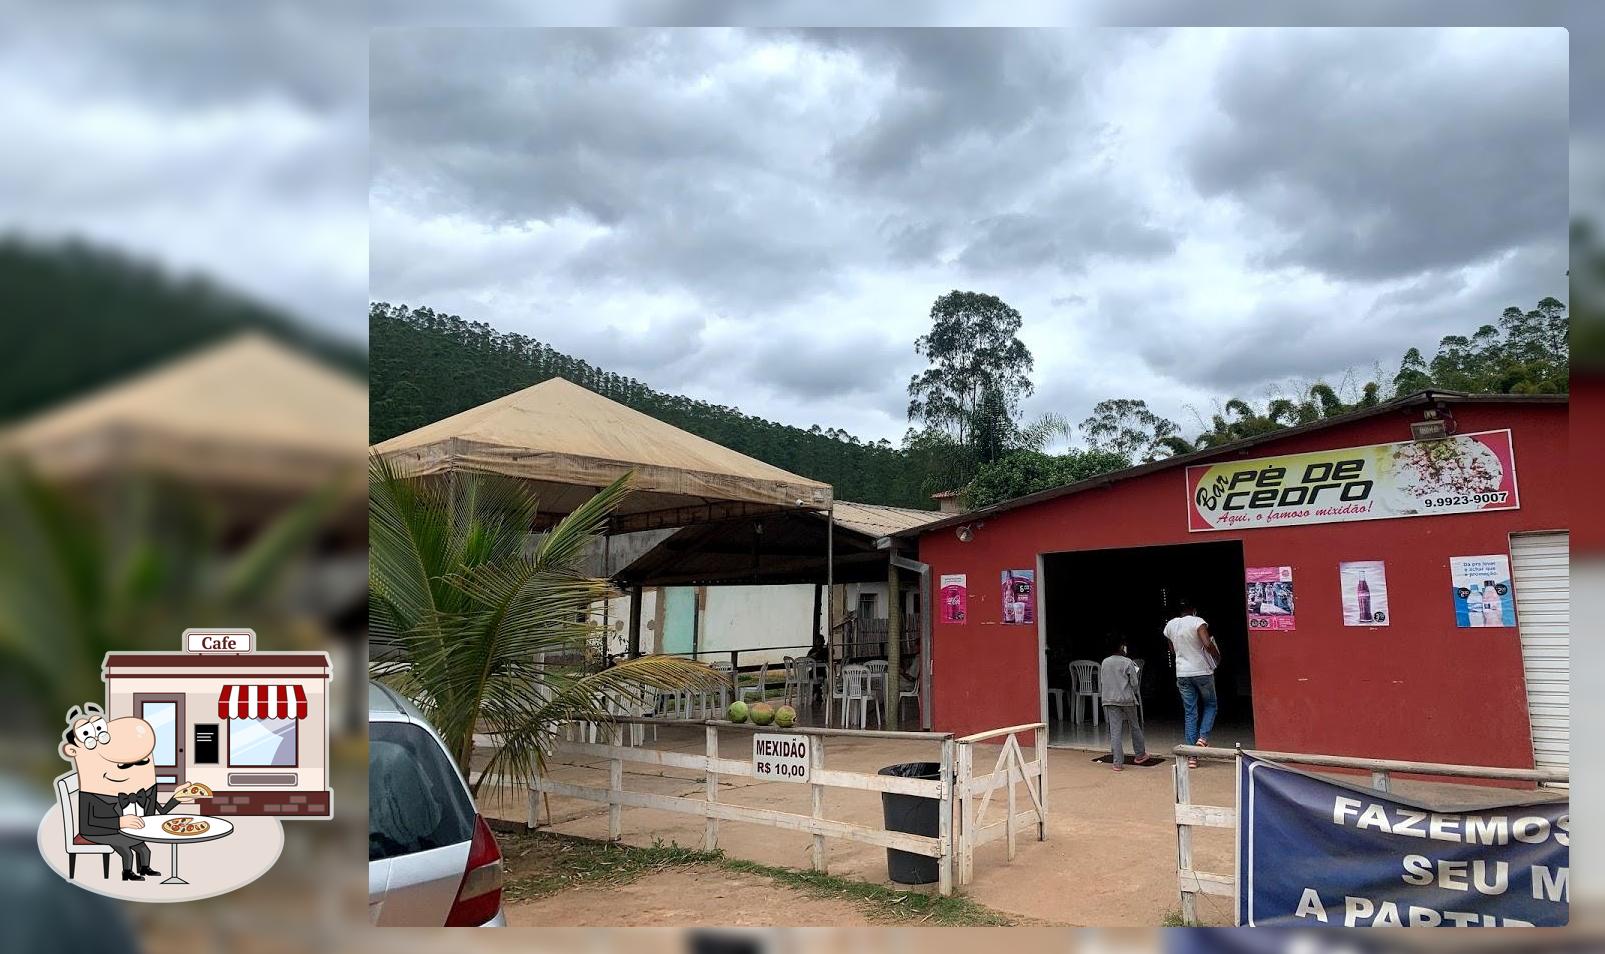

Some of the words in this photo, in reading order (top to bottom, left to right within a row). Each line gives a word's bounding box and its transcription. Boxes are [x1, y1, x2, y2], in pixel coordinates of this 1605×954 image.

[1196, 475, 1229, 511] Bar
[1424, 491, 1508, 508] 9.9923-9007
[1216, 511, 1250, 527] Aqui,
[1256, 512, 1263, 521] o
[1266, 509, 1312, 524] famoso
[1315, 500, 1373, 516] mixidão!
[756, 738, 806, 759] MEXIDÃO
[757, 762, 771, 775] R$
[775, 763, 805, 778] 10,00
[1402, 854, 1509, 896] SEU
[1295, 887, 1329, 923] A
[1344, 896, 1537, 927] PART
